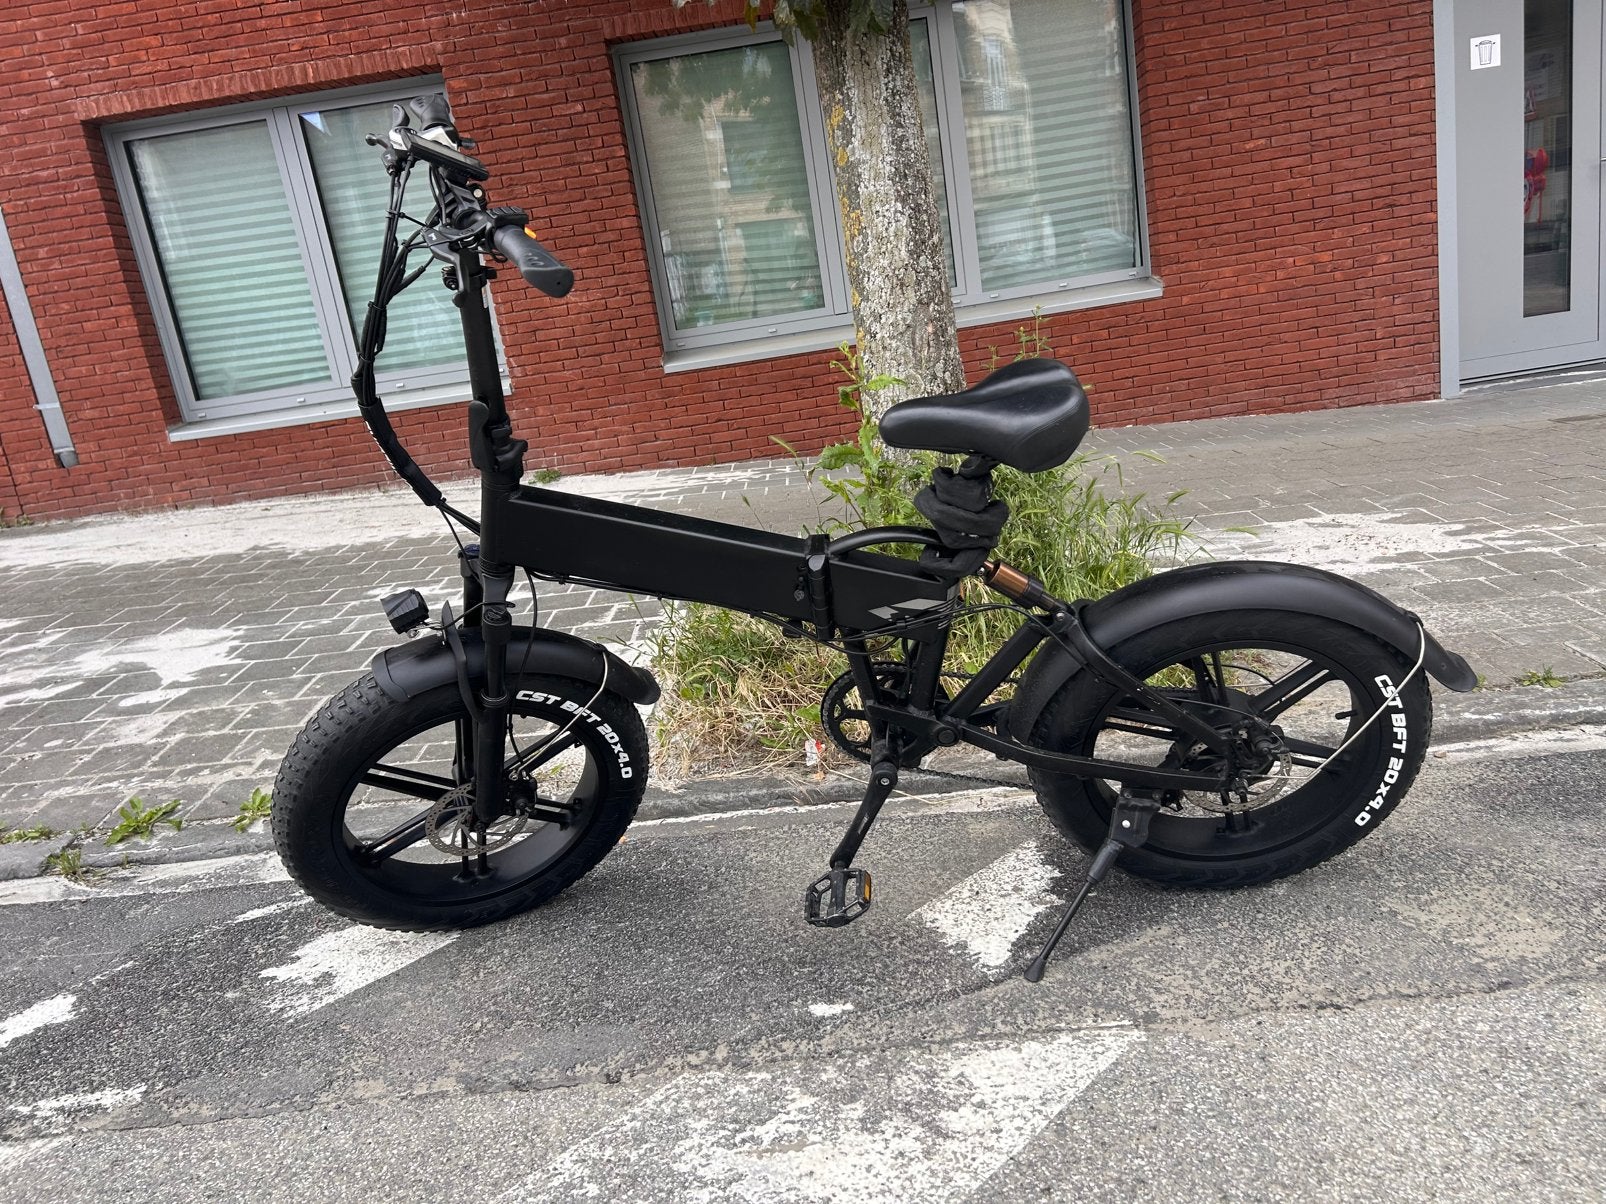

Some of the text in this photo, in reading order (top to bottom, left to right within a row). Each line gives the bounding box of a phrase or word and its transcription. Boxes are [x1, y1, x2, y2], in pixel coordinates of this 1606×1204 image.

[516, 690, 633, 779] CST BFT 20x4.0
[1354, 674, 1407, 827] CST BFT 20x4.0
